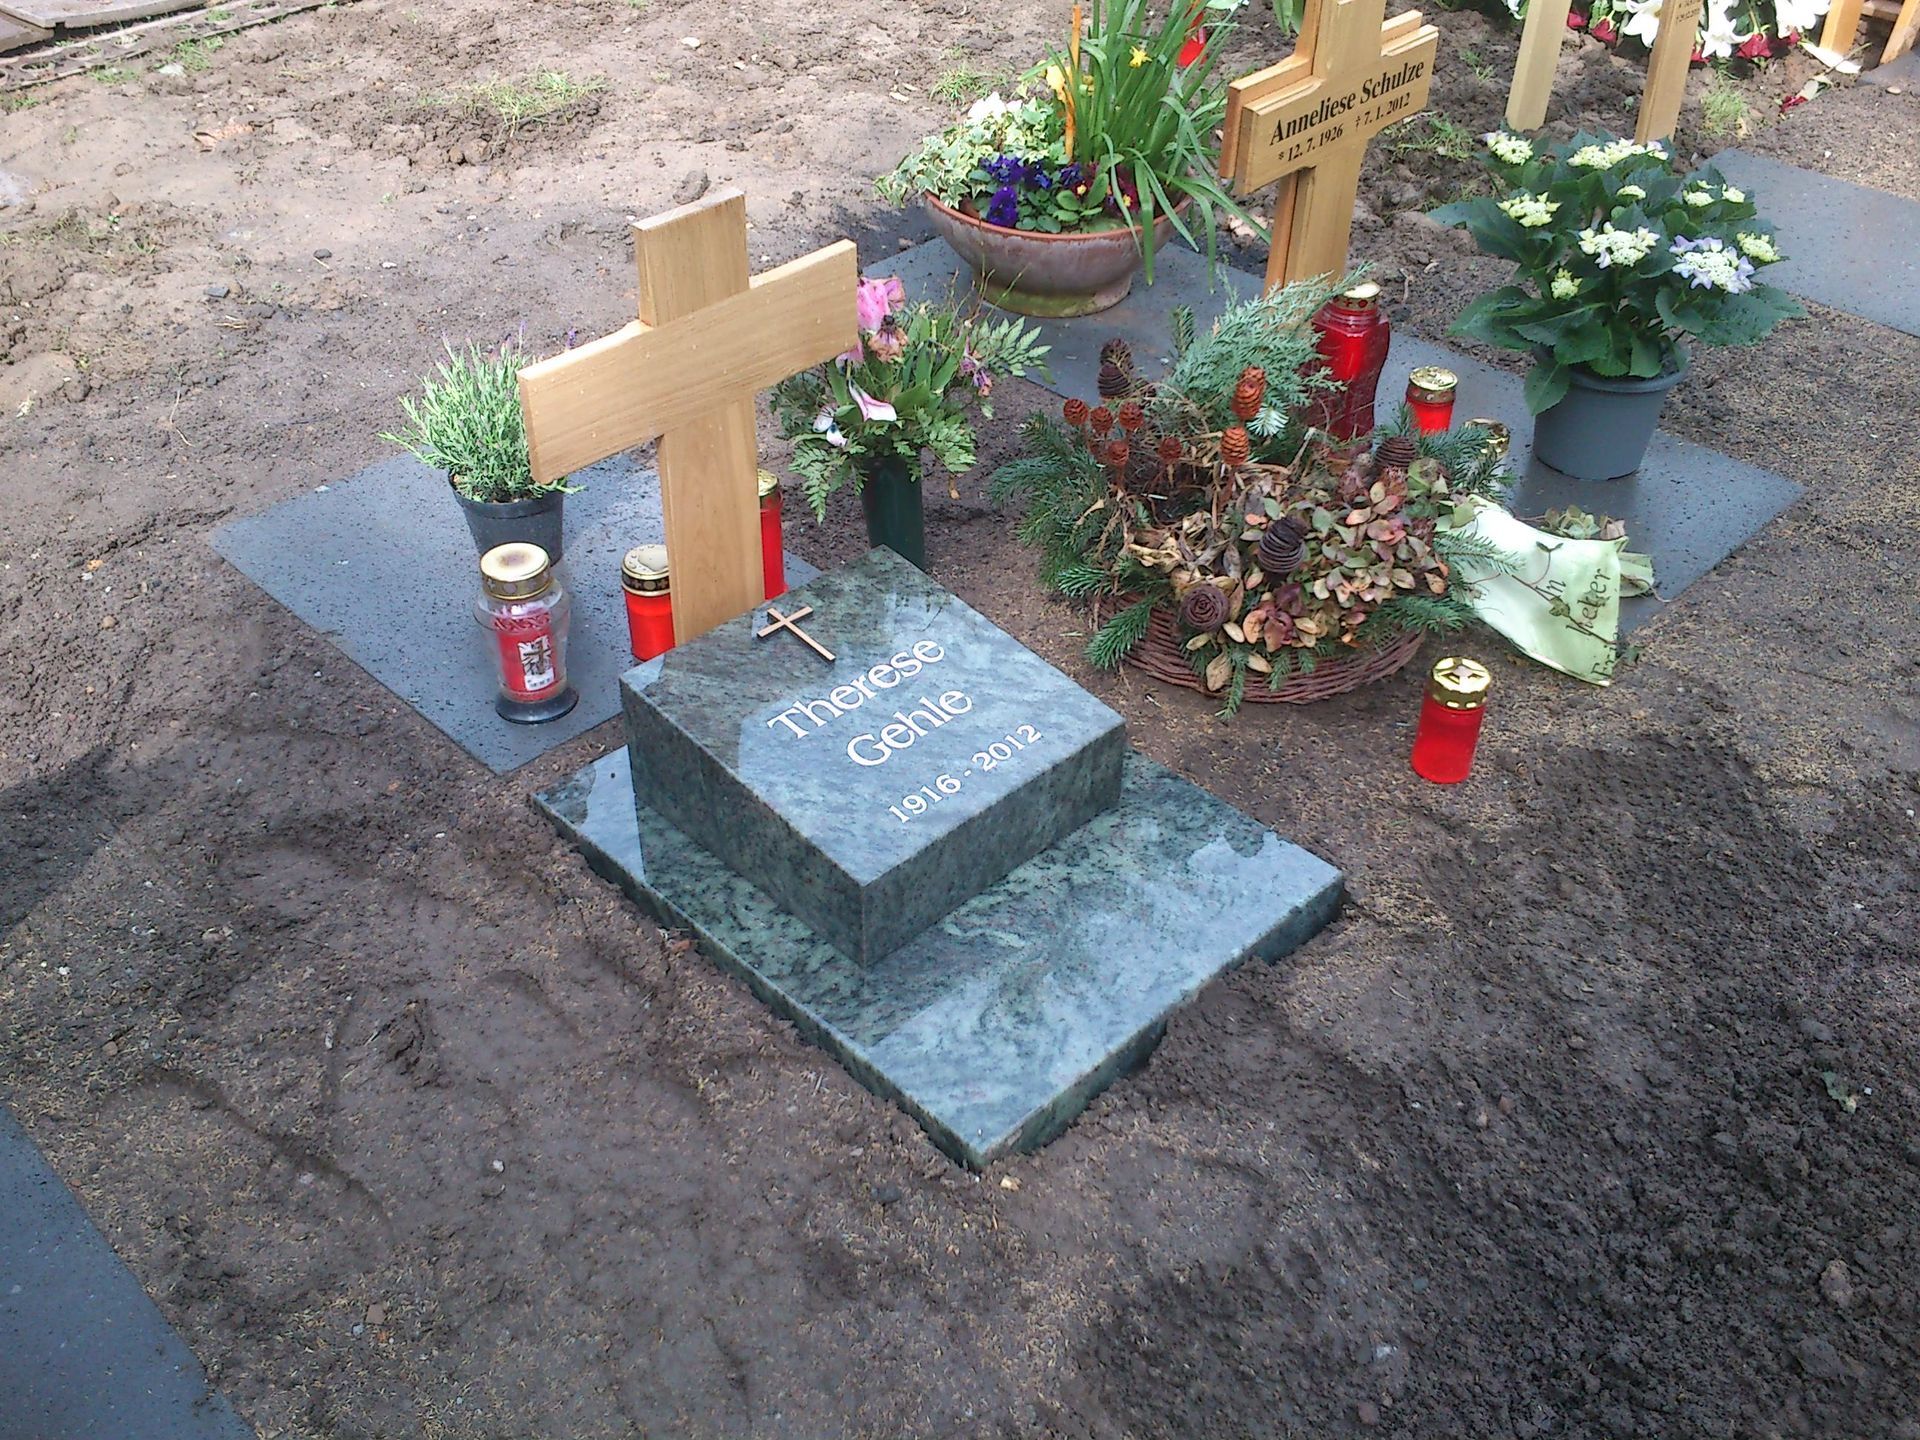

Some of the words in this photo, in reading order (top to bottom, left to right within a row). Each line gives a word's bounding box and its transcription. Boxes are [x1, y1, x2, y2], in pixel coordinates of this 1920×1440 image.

[1270, 92, 1356, 146] Anneliese
[1360, 61, 1425, 104] Schulze
[767, 639, 945, 740] Therese
[846, 689, 973, 766] Gehle
[888, 774, 962, 823] 1916
[971, 724, 1042, 772] 2012
